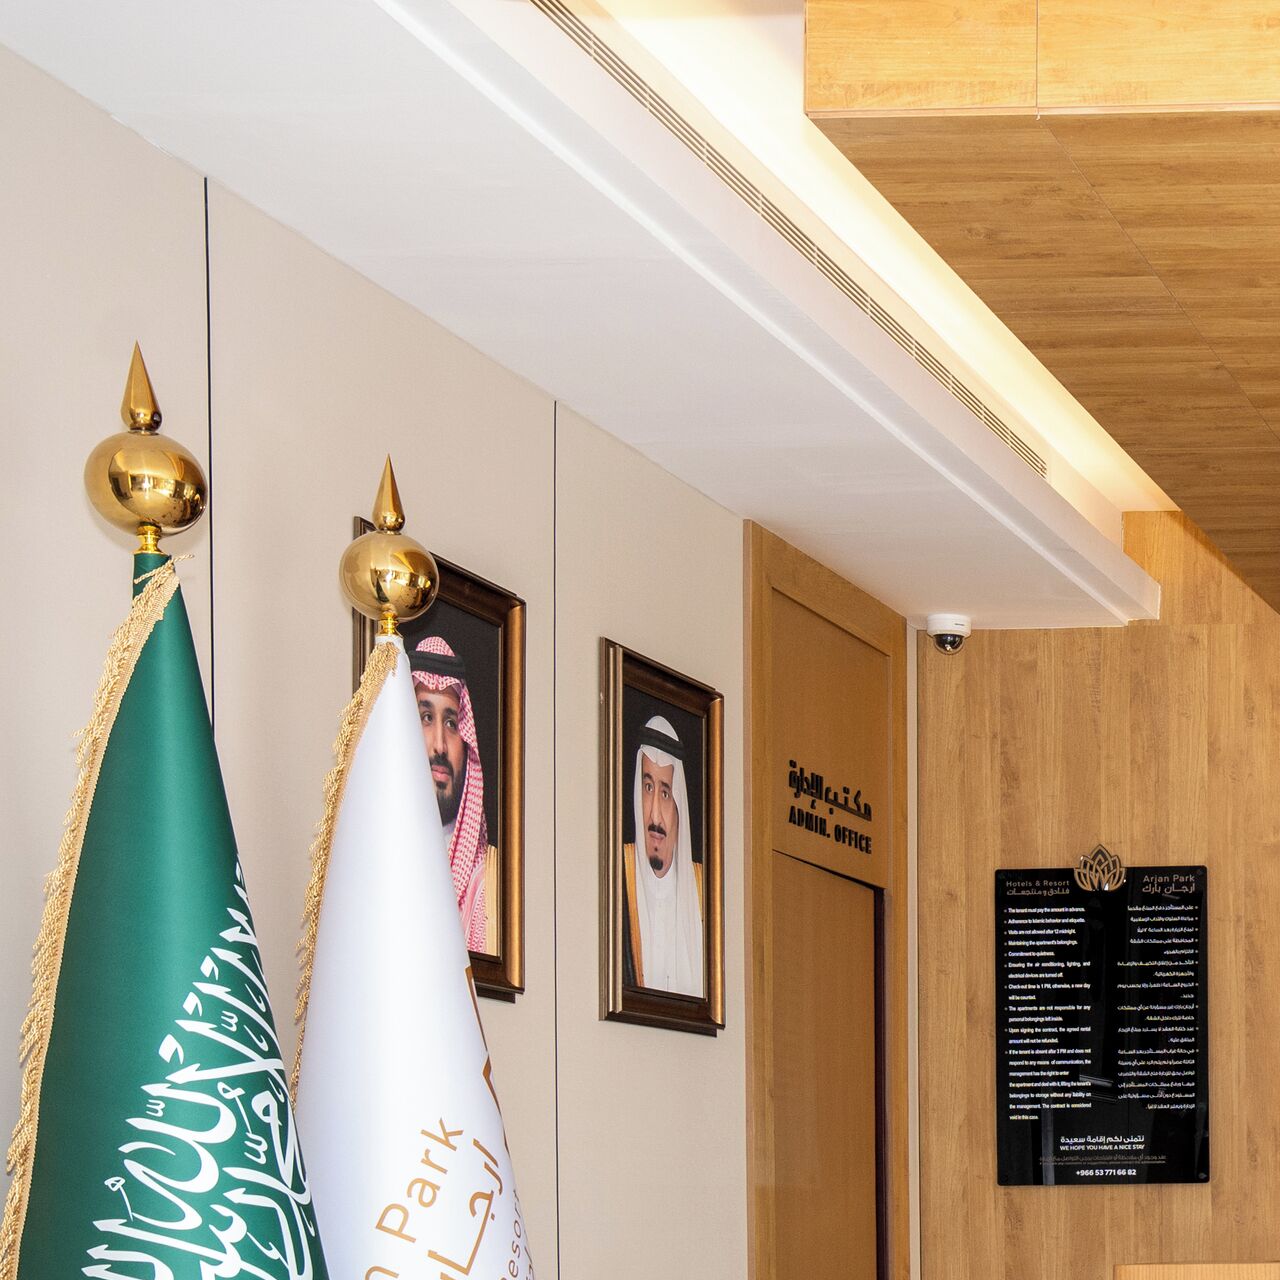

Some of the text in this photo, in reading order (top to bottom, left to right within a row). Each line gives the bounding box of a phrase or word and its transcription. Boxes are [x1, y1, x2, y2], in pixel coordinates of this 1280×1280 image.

[789, 805, 872, 854] ADMIN. OFFICE
[1143, 874, 1195, 883] Arjan Park
[376, 1117, 463, 1243] Park
